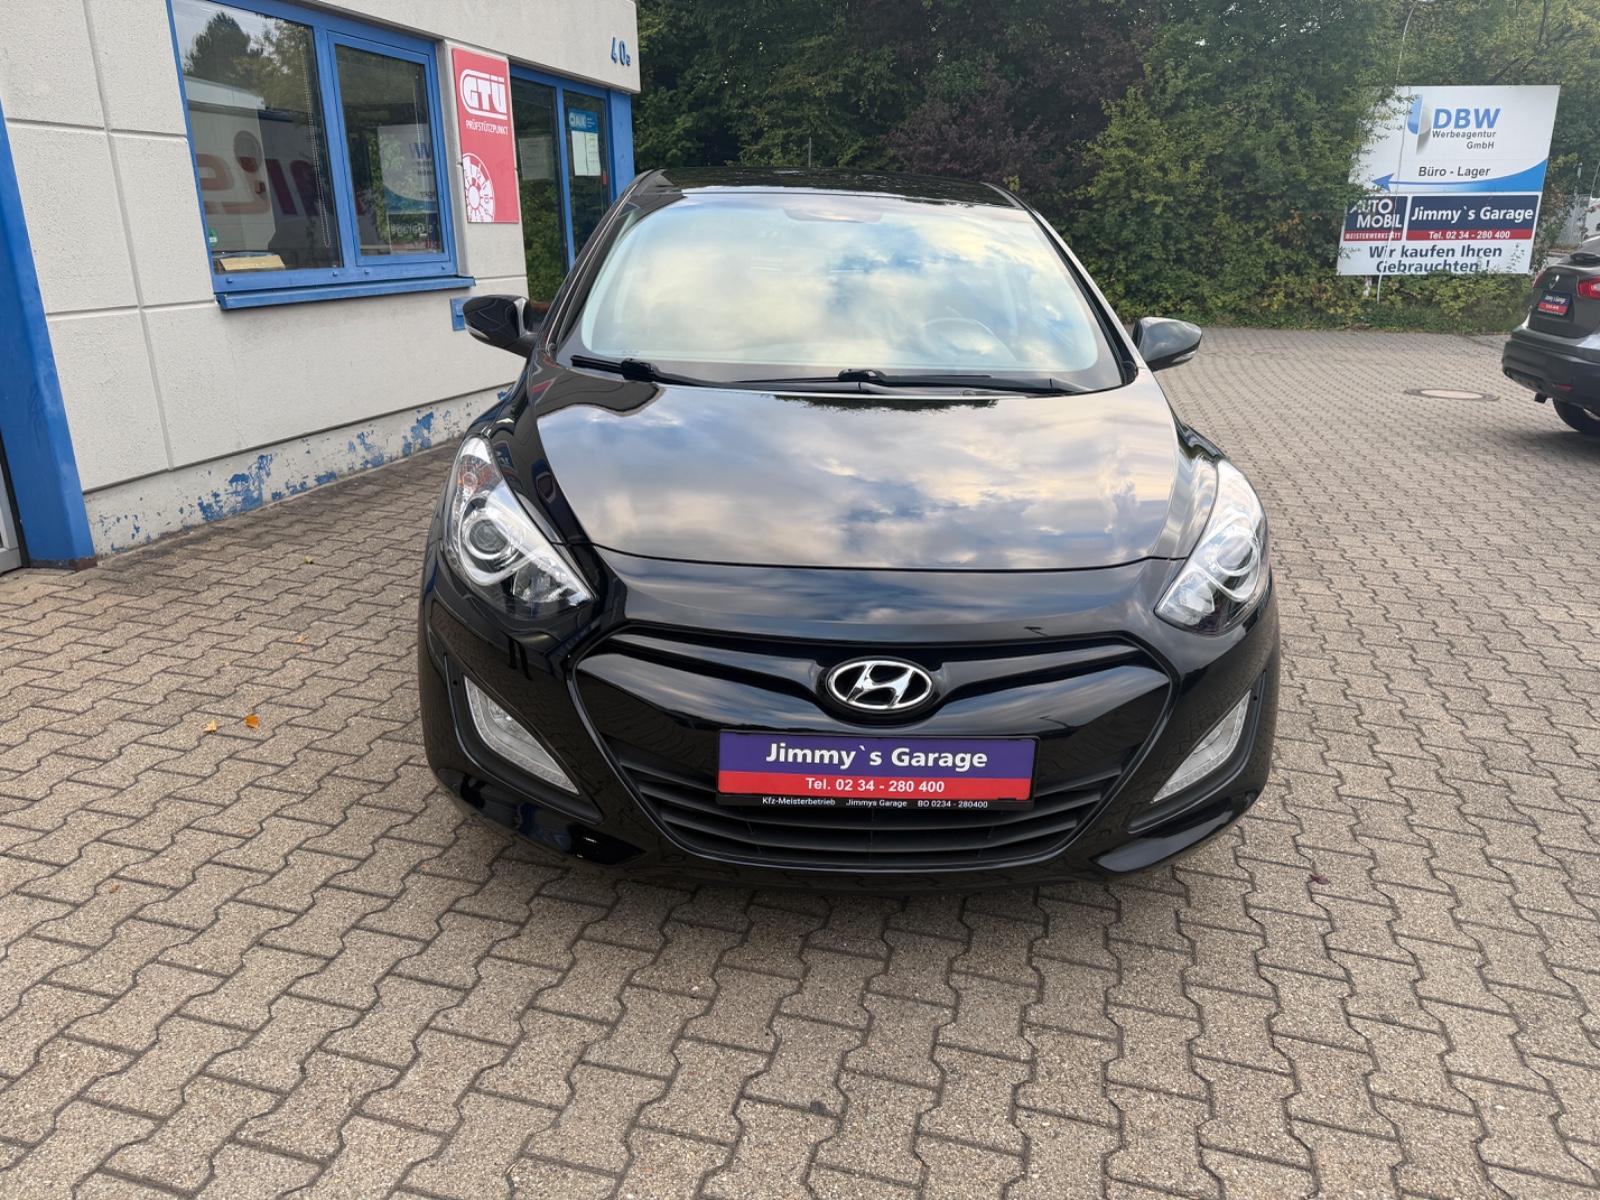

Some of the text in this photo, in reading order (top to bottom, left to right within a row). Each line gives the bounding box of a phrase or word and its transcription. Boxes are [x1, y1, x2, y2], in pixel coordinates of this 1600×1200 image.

[461, 70, 508, 117] GTÜ
[1433, 108, 1501, 129] DBW
[465, 119, 509, 136] PRÜFSTÜTZPUNKT
[1432, 130, 1497, 139] Werbeagentur
[1466, 141, 1495, 150] GmbH
[1418, 166, 1447, 177] Büro
[1457, 166, 1491, 179] Lager
[1356, 213, 1402, 229] MOBIL
[1480, 206, 1534, 224] Garage
[1428, 231, 1444, 239] Tel.
[1446, 231, 1456, 239] 02
[1458, 231, 1469, 239] 34
[1477, 231, 1492, 239] 280
[1494, 231, 1510, 239] 400
[1400, 244, 1456, 258] kaufen
[1461, 244, 1503, 258] Ihren
[891, 748, 988, 772] Garage
[806, 778, 831, 790] Tel.
[836, 779, 853, 791] 02
[858, 779, 875, 792] 34
[888, 781, 915, 793] 280
[919, 781, 945, 793] 400
[762, 796, 836, 806] Kfz-Meisterbetrieb
[846, 799, 877, 808] Jimmys
[879, 799, 907, 808] Garage
[931, 800, 951, 809] 0234
[958, 801, 988, 810] 280400
